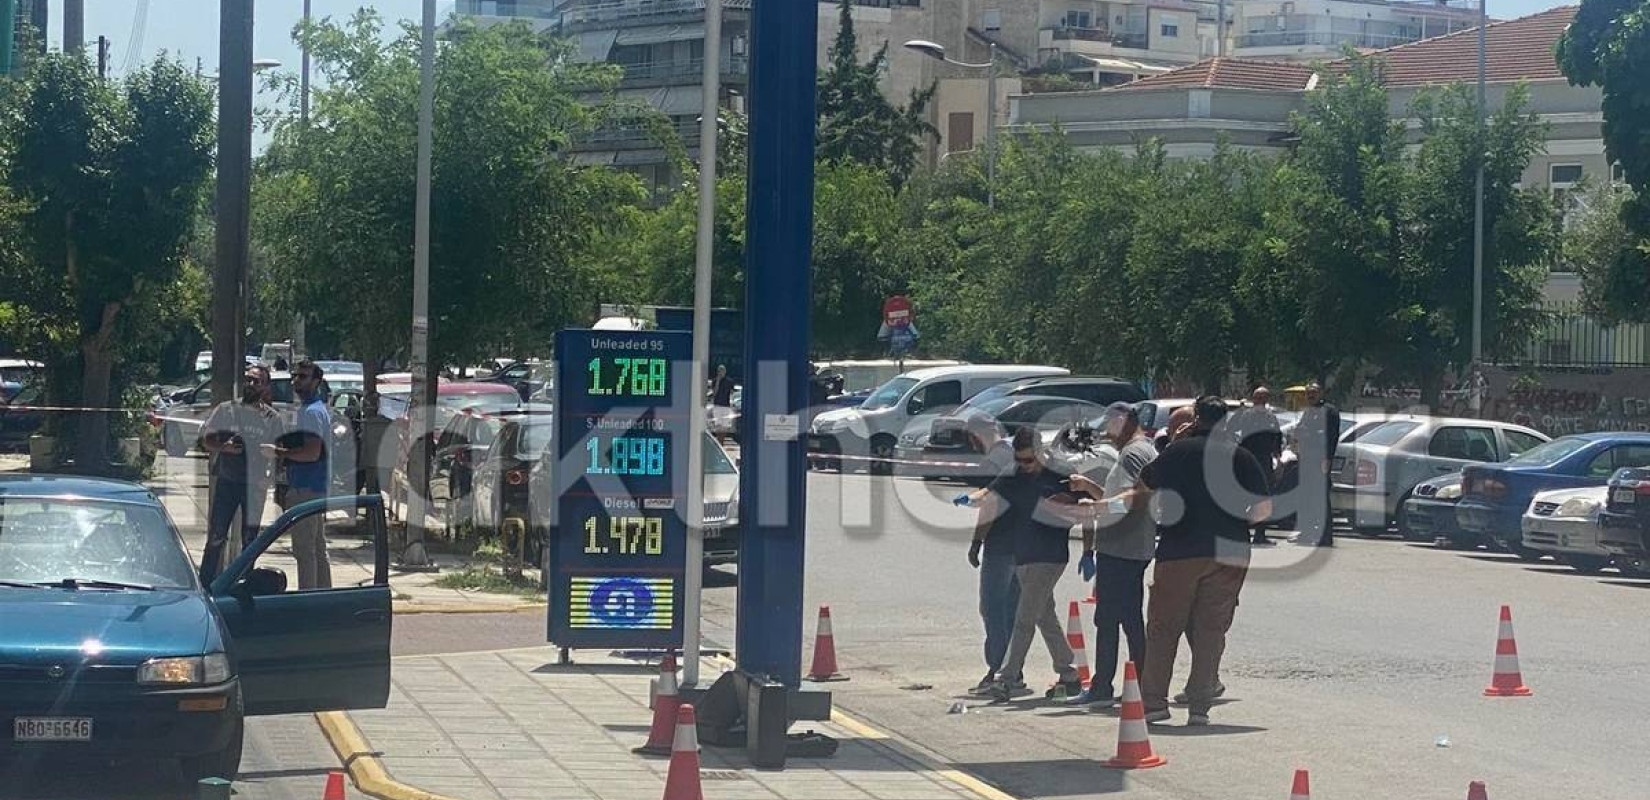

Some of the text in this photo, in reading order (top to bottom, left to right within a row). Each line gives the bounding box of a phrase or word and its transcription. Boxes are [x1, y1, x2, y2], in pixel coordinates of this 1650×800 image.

[591, 338, 664, 351] Unleaded 95
[588, 357, 666, 396] 1.768
[647, 419, 664, 431] 100
[586, 436, 664, 475] 1.898
[604, 497, 640, 508] Diesel
[584, 516, 662, 554] 1.478
